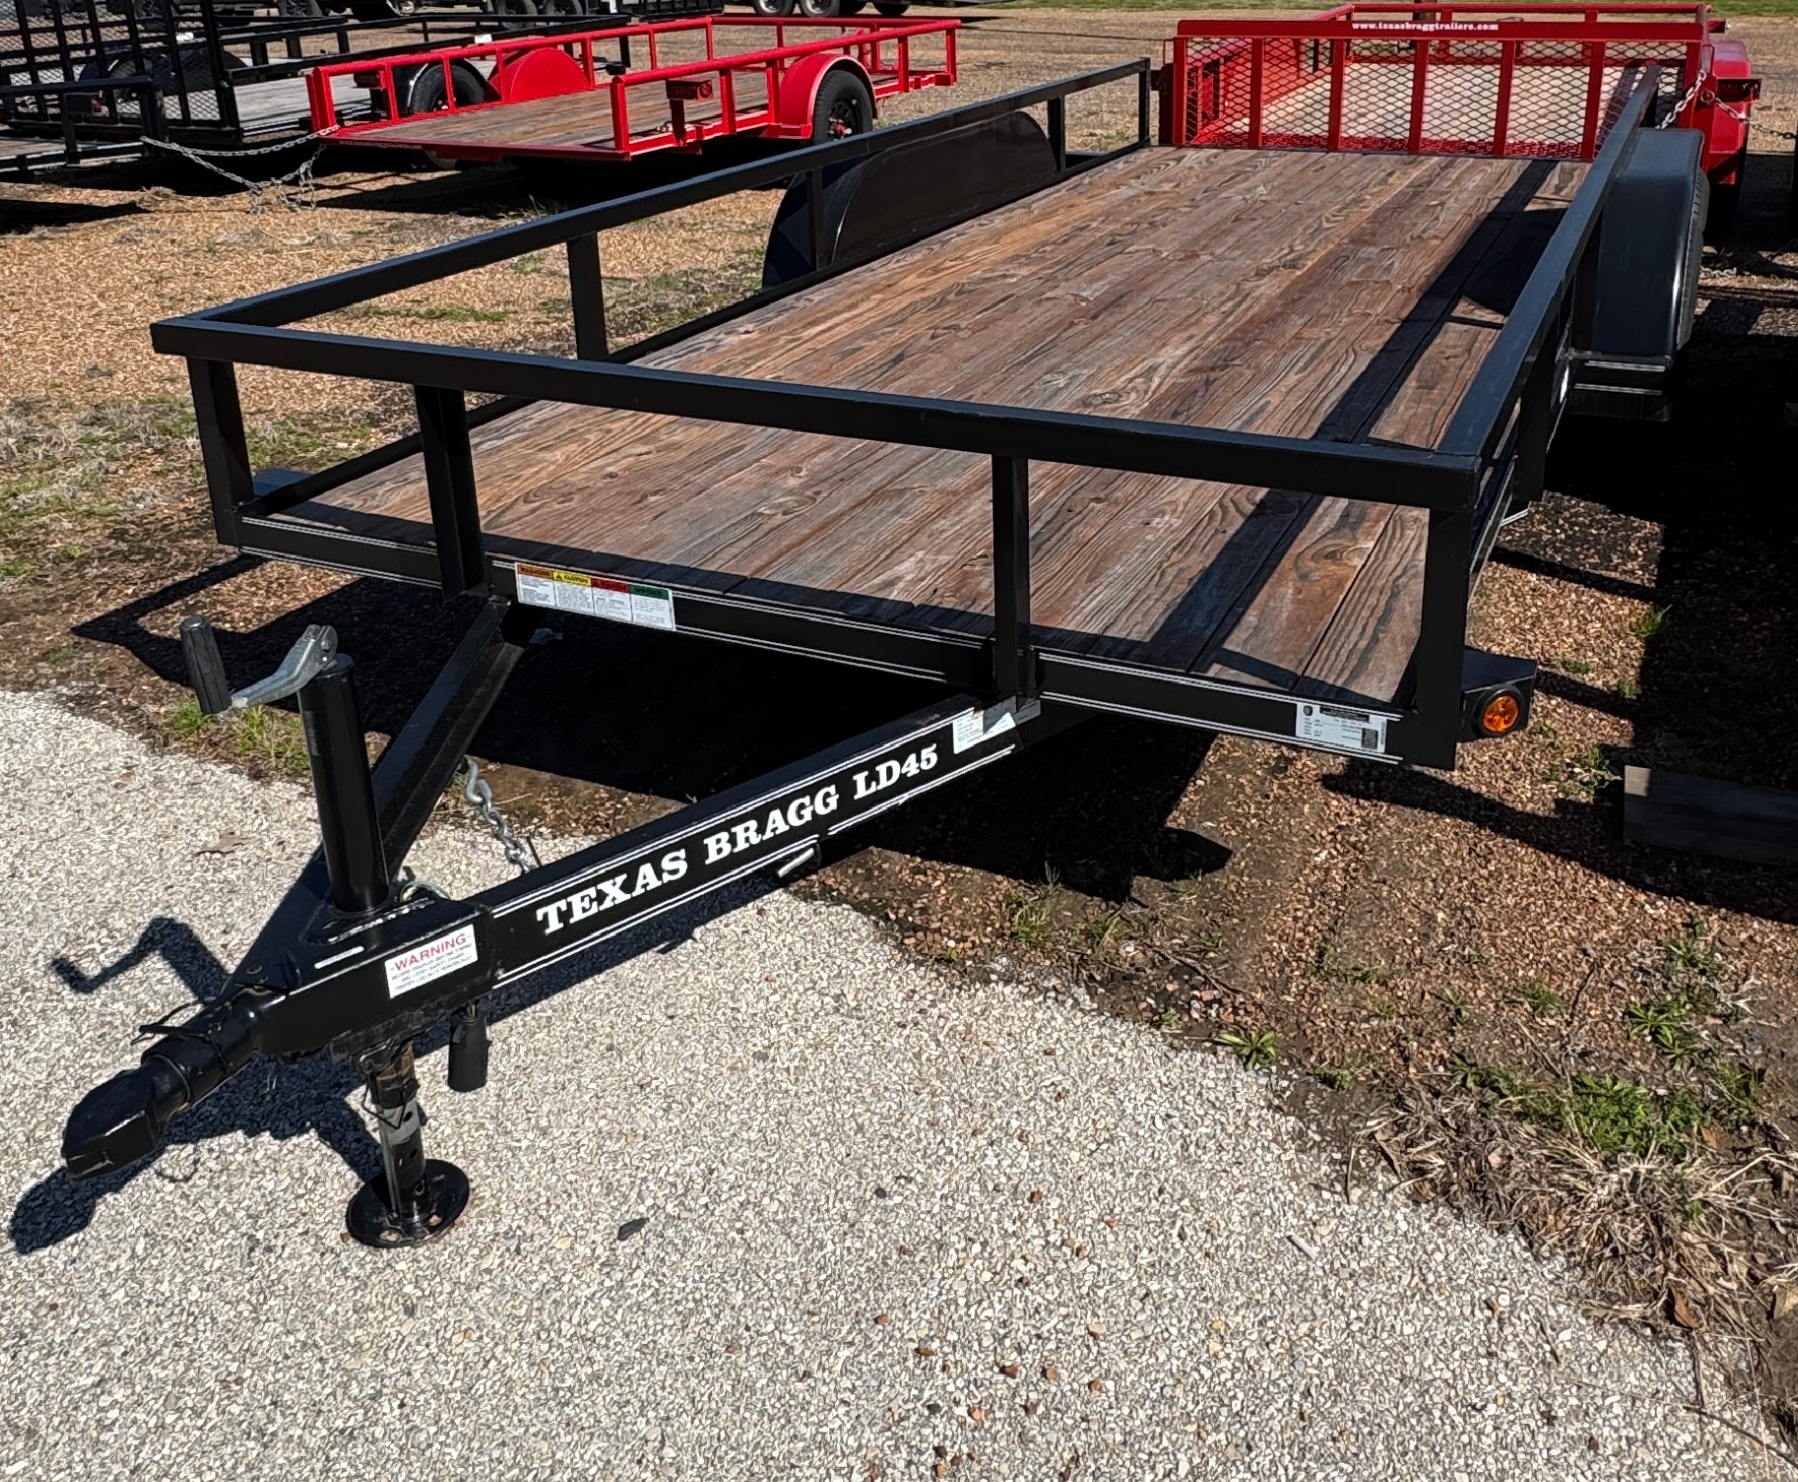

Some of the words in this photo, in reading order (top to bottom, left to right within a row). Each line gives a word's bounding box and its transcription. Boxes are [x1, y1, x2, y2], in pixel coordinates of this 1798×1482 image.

[1352, 21, 1499, 31] www.texasbraggtrailers.com
[536, 848, 688, 936] TEXAS
[703, 784, 839, 866] BRAGG
[853, 744, 938, 800] LD45
[394, 932, 467, 971] WARNING
